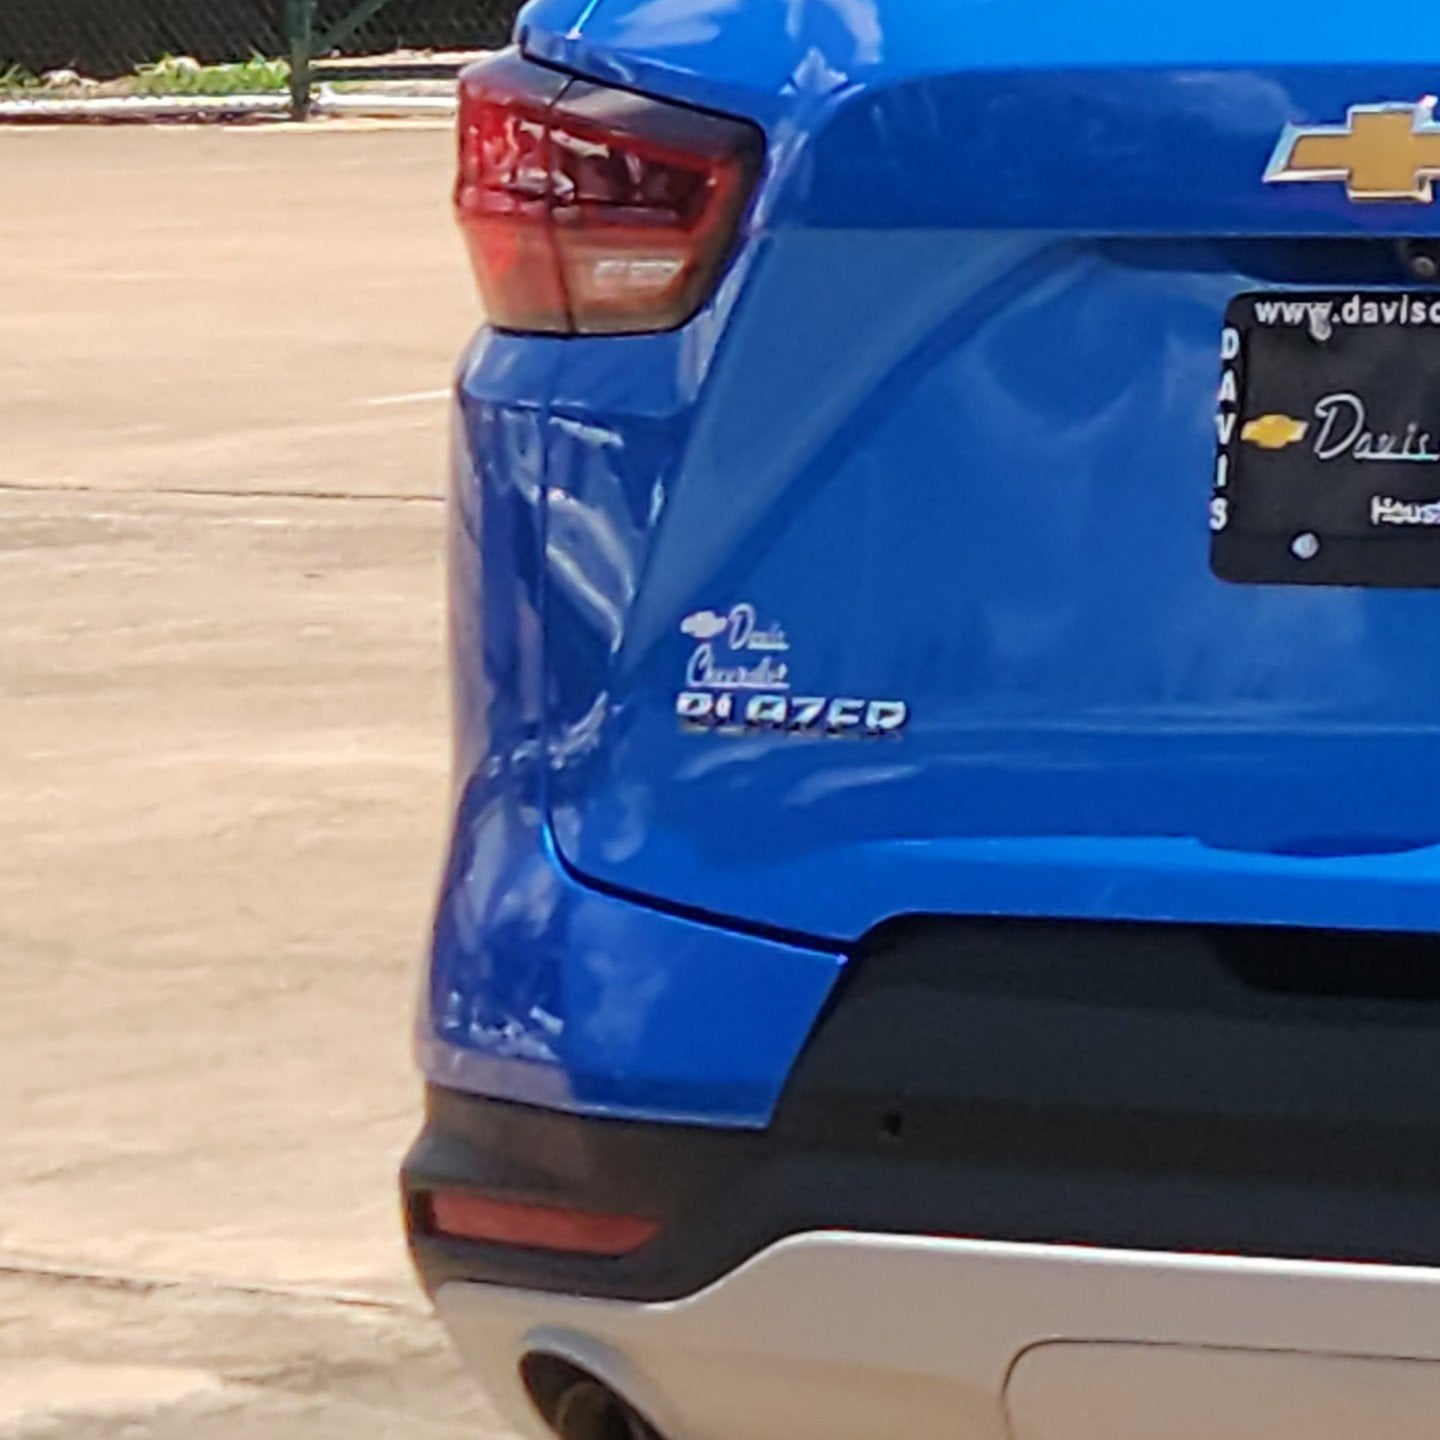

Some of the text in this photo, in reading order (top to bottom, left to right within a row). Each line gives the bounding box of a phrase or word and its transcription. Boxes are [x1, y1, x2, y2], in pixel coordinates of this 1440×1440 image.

[1209, 327, 1240, 531] DAVIS
[1313, 393, 1440, 460] Davis
[675, 692, 908, 735] BLAZER
